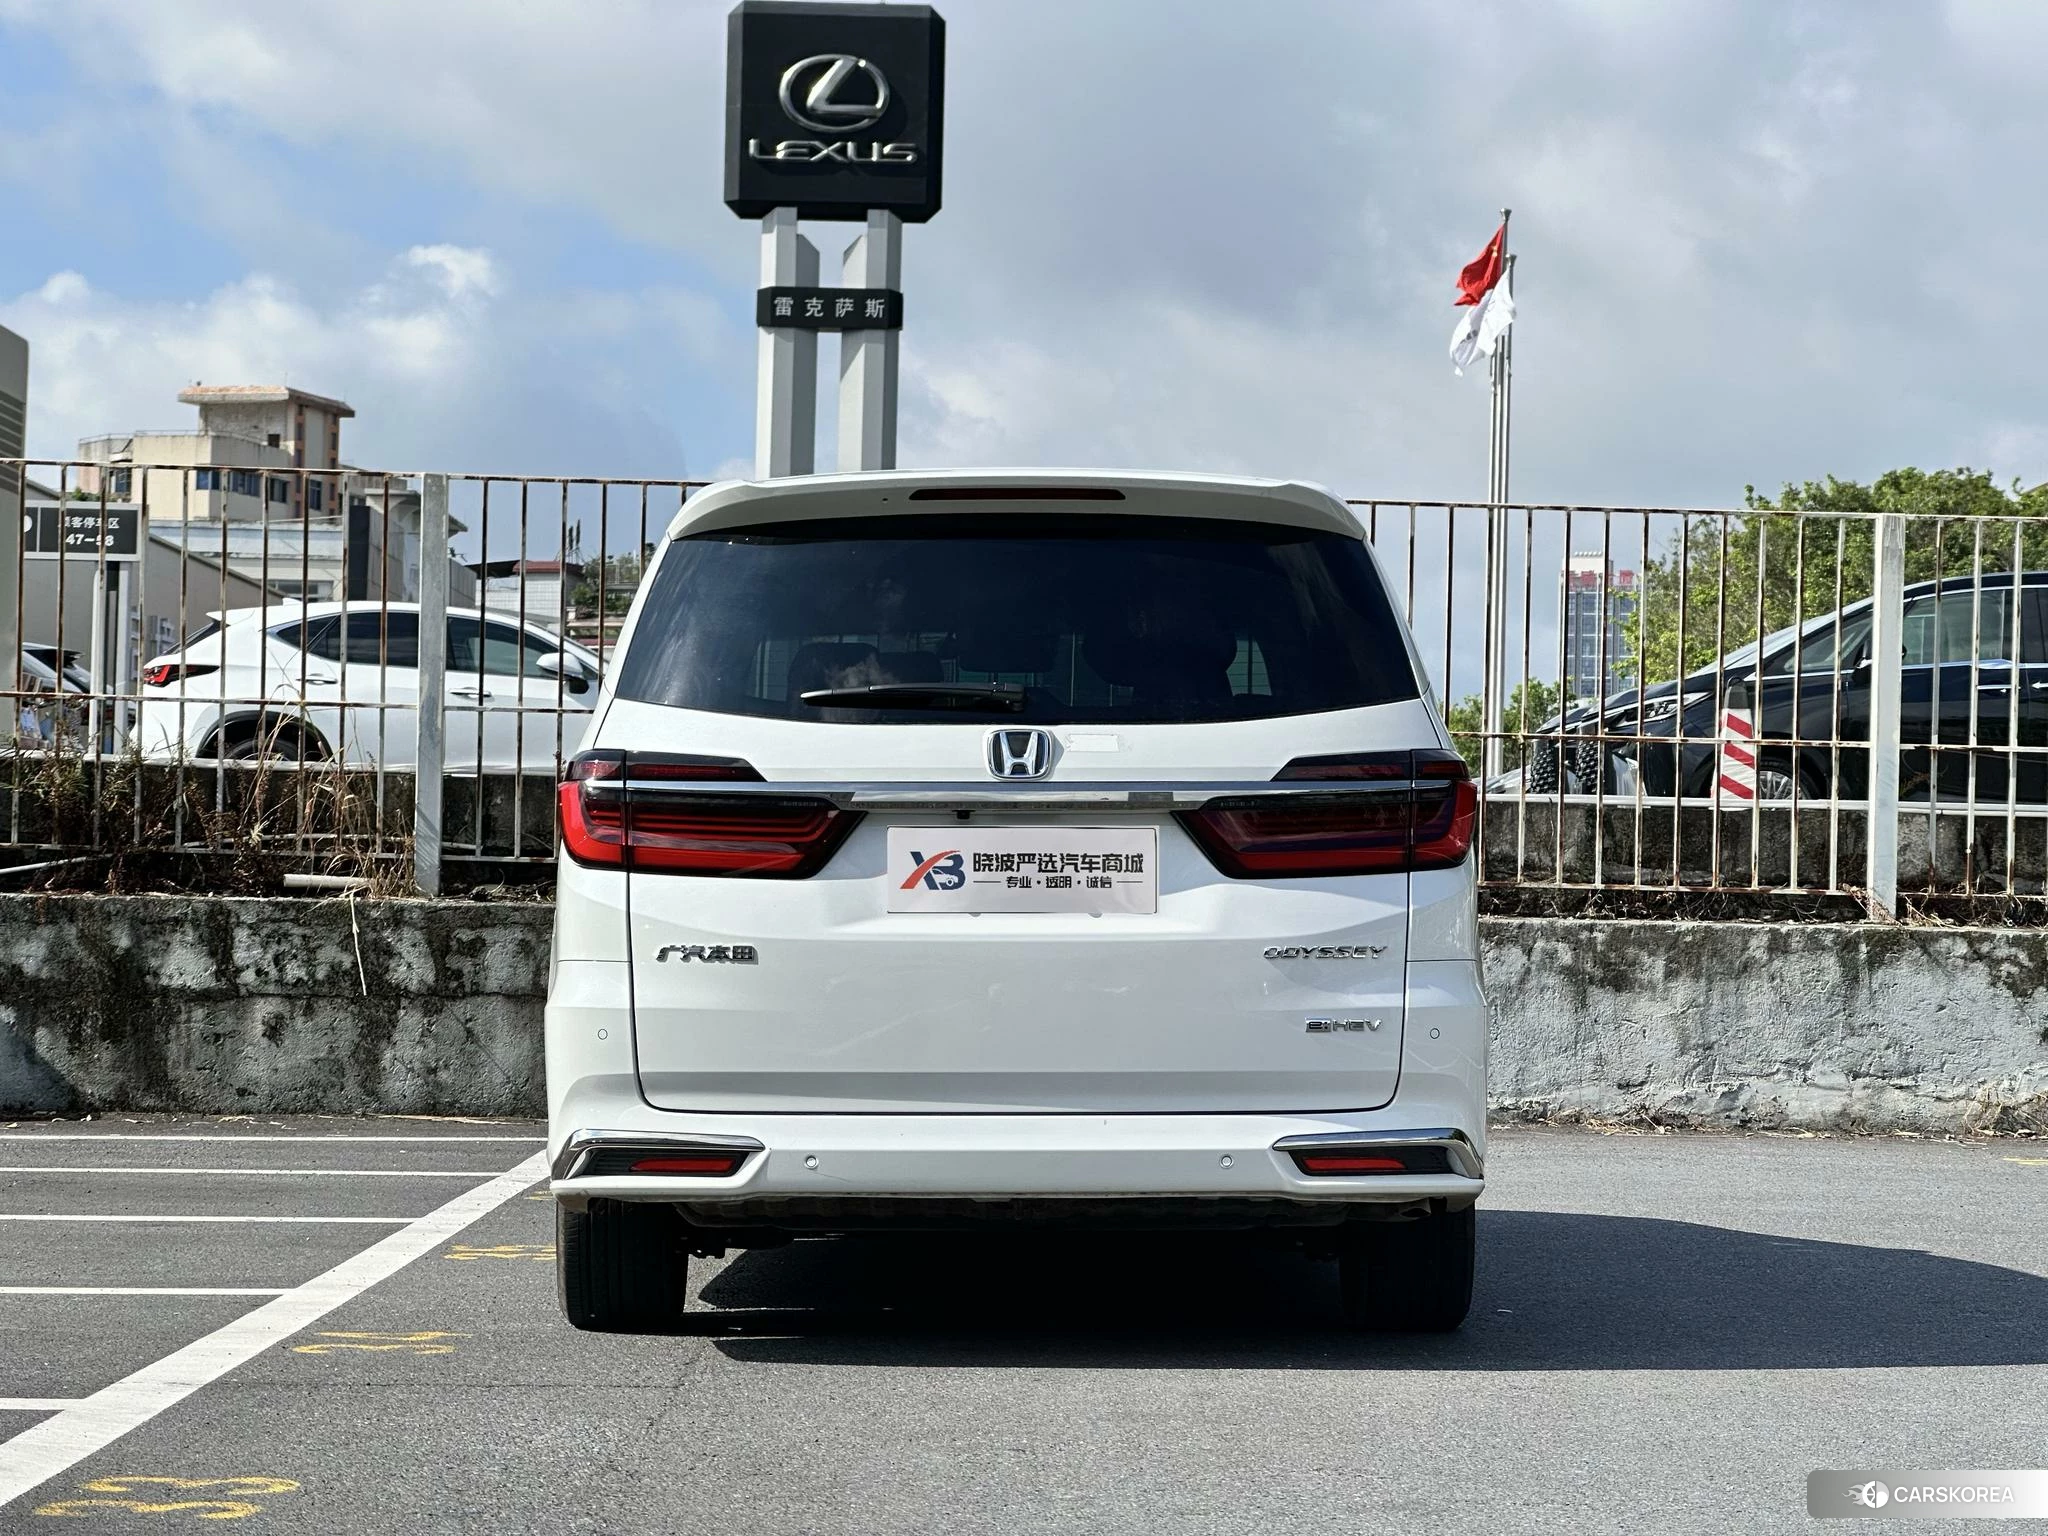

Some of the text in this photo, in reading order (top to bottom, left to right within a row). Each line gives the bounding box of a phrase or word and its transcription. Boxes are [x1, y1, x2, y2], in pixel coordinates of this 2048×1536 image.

[749, 138, 918, 162] LEXUS
[773, 295, 886, 319] 雷克萨斯
[972, 852, 1145, 873] 晓波严选汽车商城
[655, 944, 759, 965] 广汽本田
[1263, 945, 1388, 959] ODYSSEY
